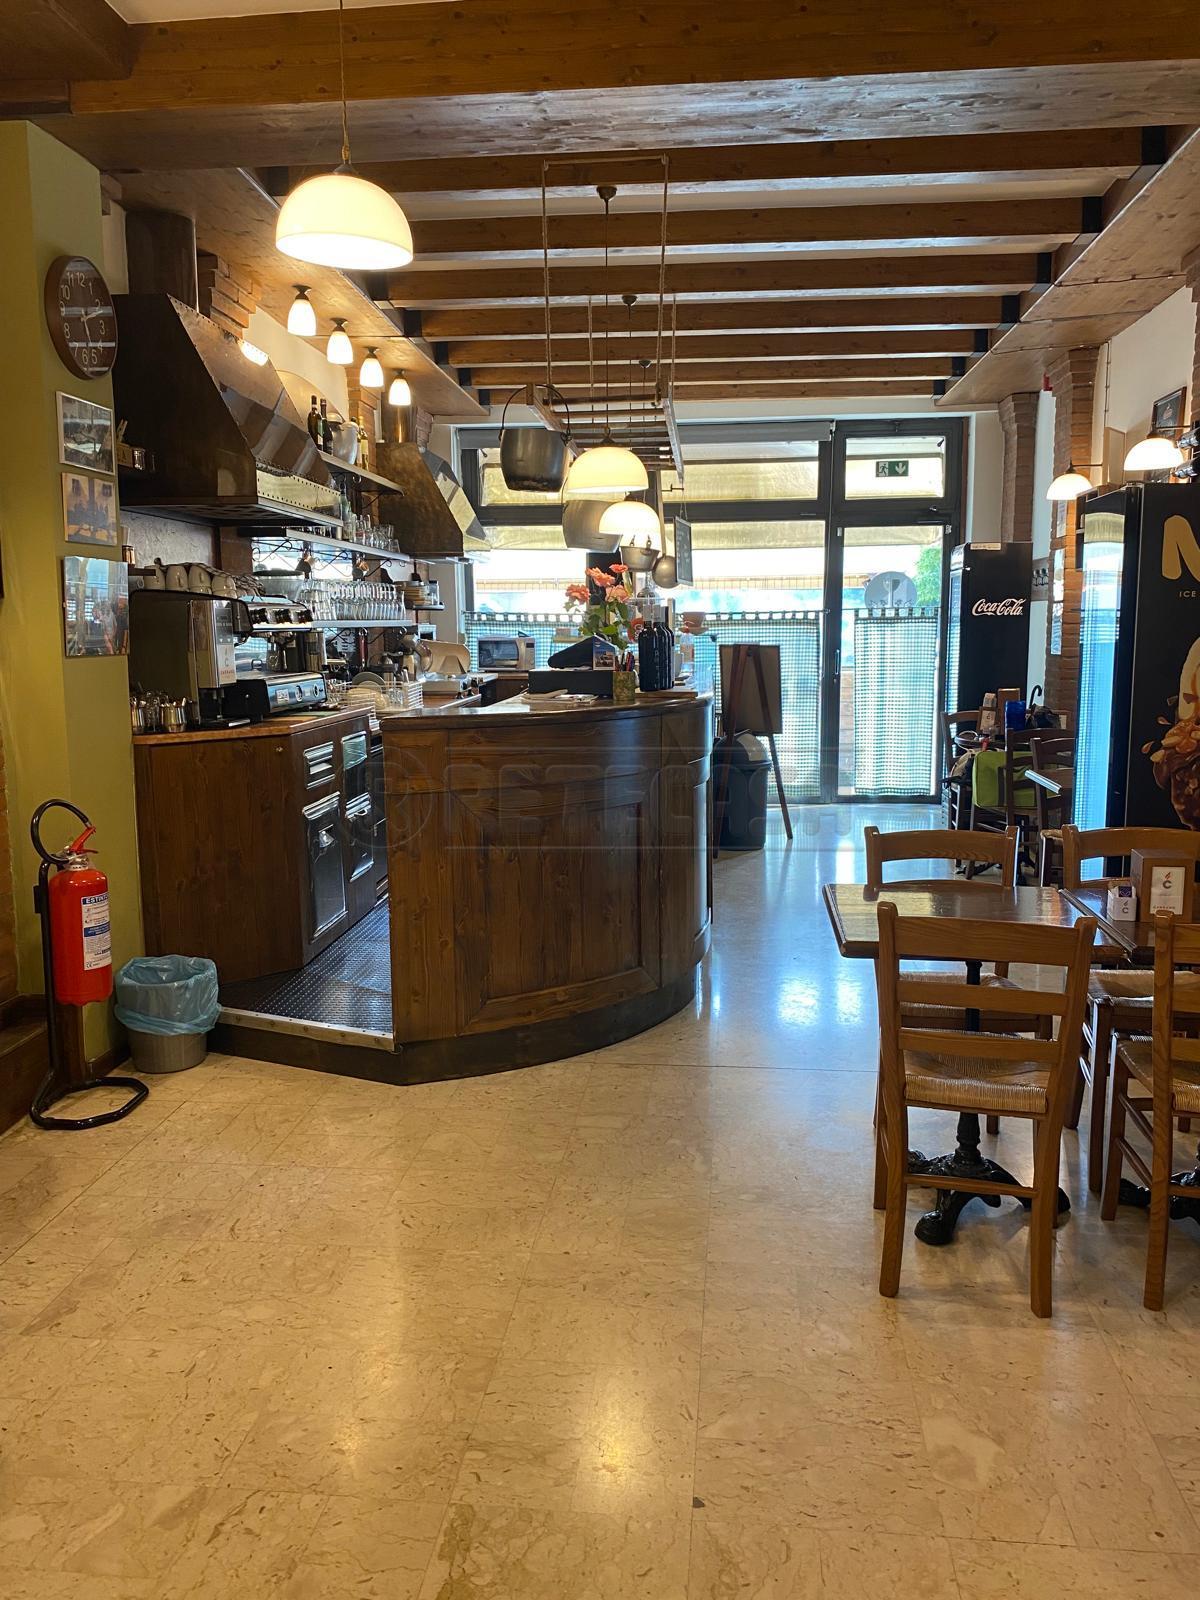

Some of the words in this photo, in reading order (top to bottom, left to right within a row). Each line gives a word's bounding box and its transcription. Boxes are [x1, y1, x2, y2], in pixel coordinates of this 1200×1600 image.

[66, 272, 74, 288] 11
[76, 272, 86, 287] 12
[60, 285, 71, 300] 10
[64, 322, 71, 339] 8
[99, 319, 106, 335] 3
[72, 341, 79, 357] 7
[81, 348, 89, 365] 6
[91, 349, 98, 365] 5
[1179, 588, 1197, 598] ICE
[972, 598, 1026, 616] Coca-Cola
